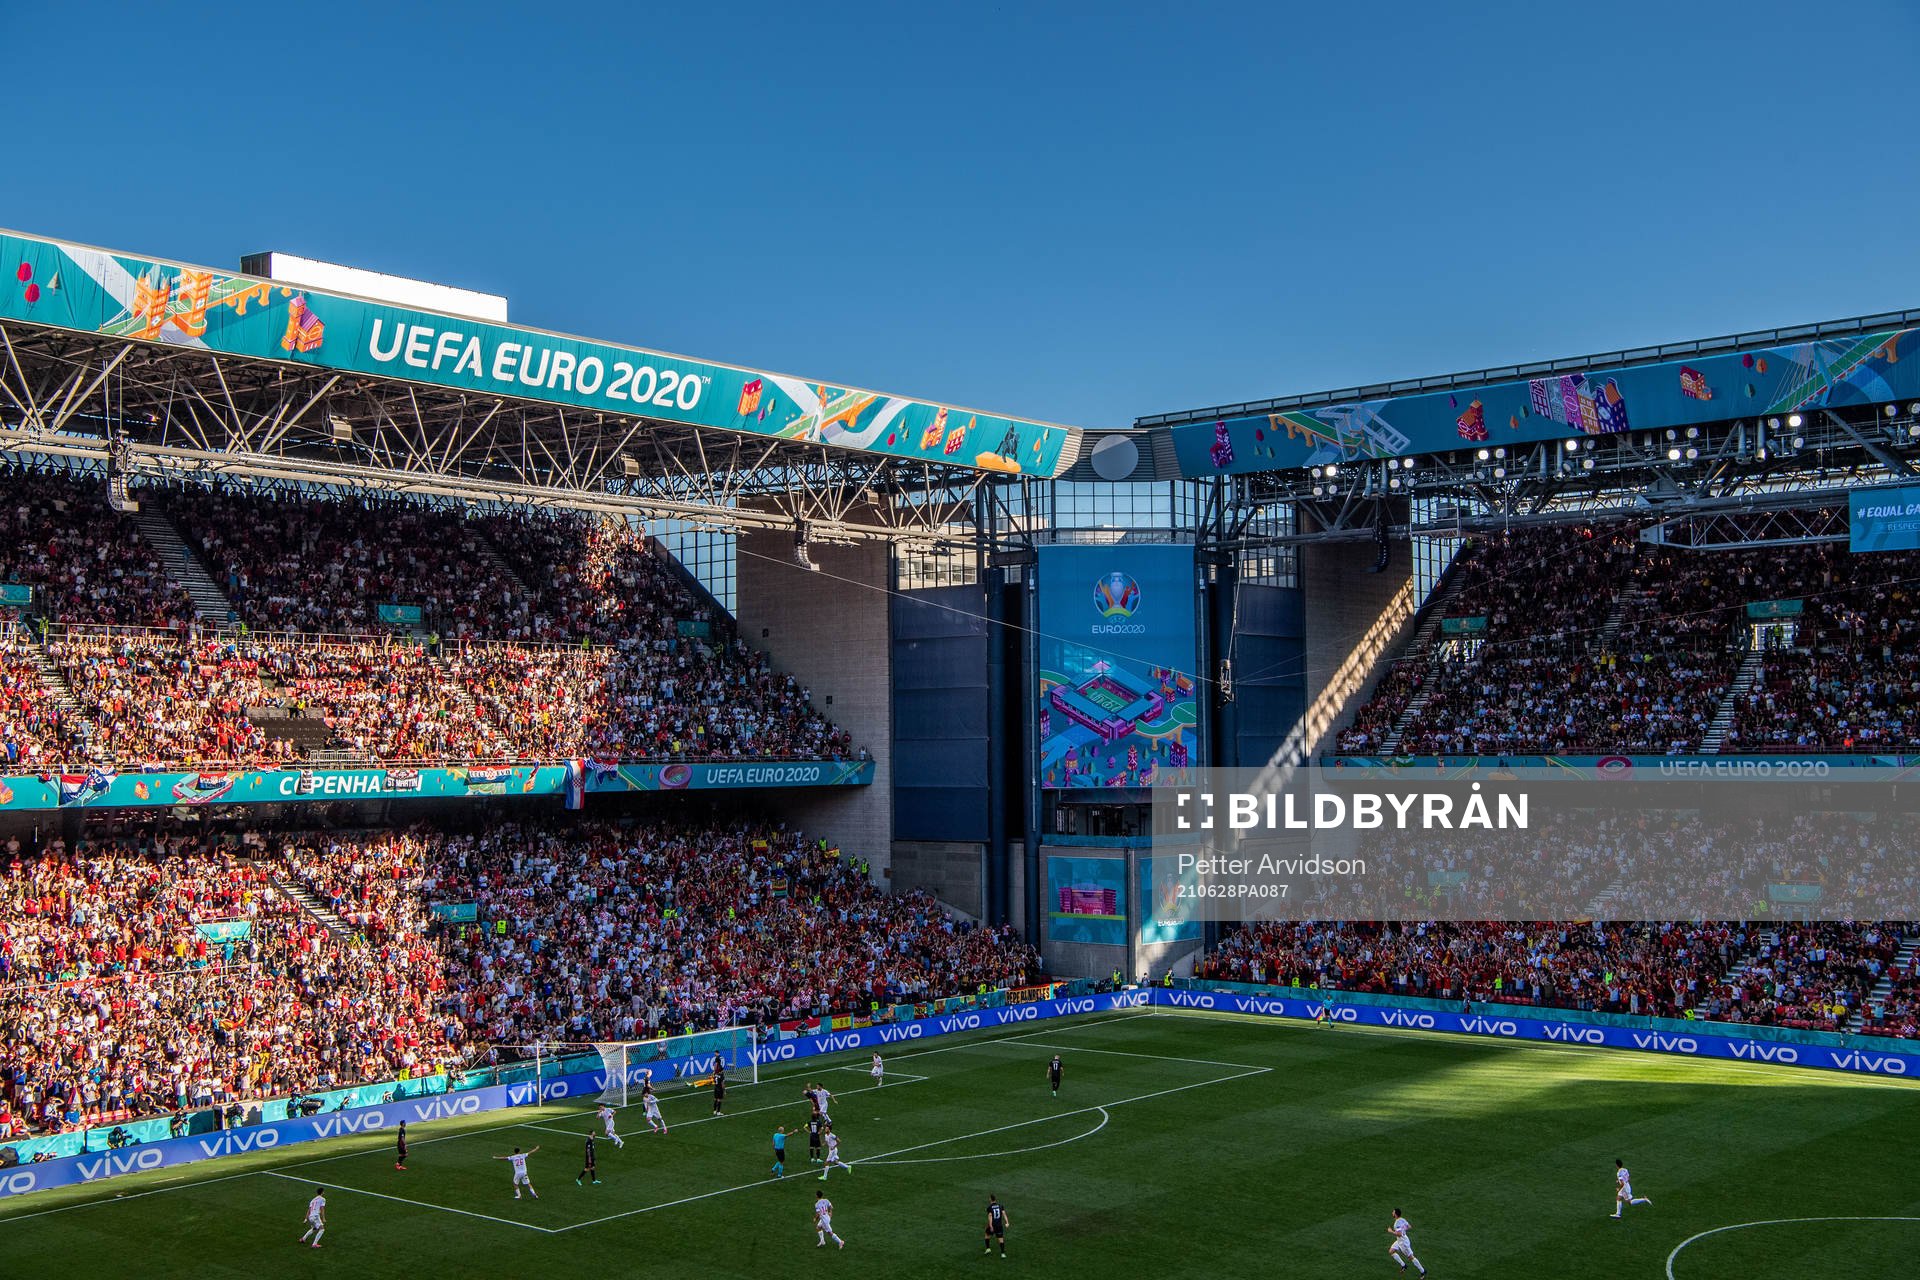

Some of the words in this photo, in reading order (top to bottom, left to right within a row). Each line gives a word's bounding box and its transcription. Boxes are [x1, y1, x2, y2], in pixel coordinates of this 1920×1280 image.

[369, 319, 483, 377] UEFA
[492, 342, 604, 395] EURO
[606, 362, 701, 411] 2020
[1857, 505, 1904, 519] #EQUAL
[707, 769, 744, 784] UEFA
[746, 767, 784, 783] EURO
[785, 767, 820, 782] 2020
[1659, 761, 1713, 776] UEFA
[1716, 761, 1771, 776] EURO
[1775, 761, 1830, 777] 2020
[280, 775, 423, 795] CPENHA
[1055, 998, 1095, 1016] vivo
[1111, 991, 1149, 1007] vivo
[1168, 990, 1215, 1009] vivo
[1235, 996, 1284, 1015] vivo
[997, 1005, 1038, 1023] vivo
[1306, 1005, 1357, 1021] vvo
[1381, 1008, 1435, 1029] vivo
[879, 1023, 922, 1043] vivo
[940, 1014, 980, 1033] vivo
[1459, 1016, 1517, 1036] vivo
[1543, 1023, 1604, 1044] vivo
[815, 1033, 861, 1053] vivo
[1633, 1031, 1698, 1053] vivo
[1728, 1040, 1798, 1063] vivo
[747, 1044, 795, 1065] vivo
[1830, 1050, 1906, 1074] vivo
[414, 1095, 480, 1120] vivo
[312, 1111, 385, 1137] vivo
[200, 1128, 279, 1157] vivo
[77, 1148, 163, 1180] vivo
